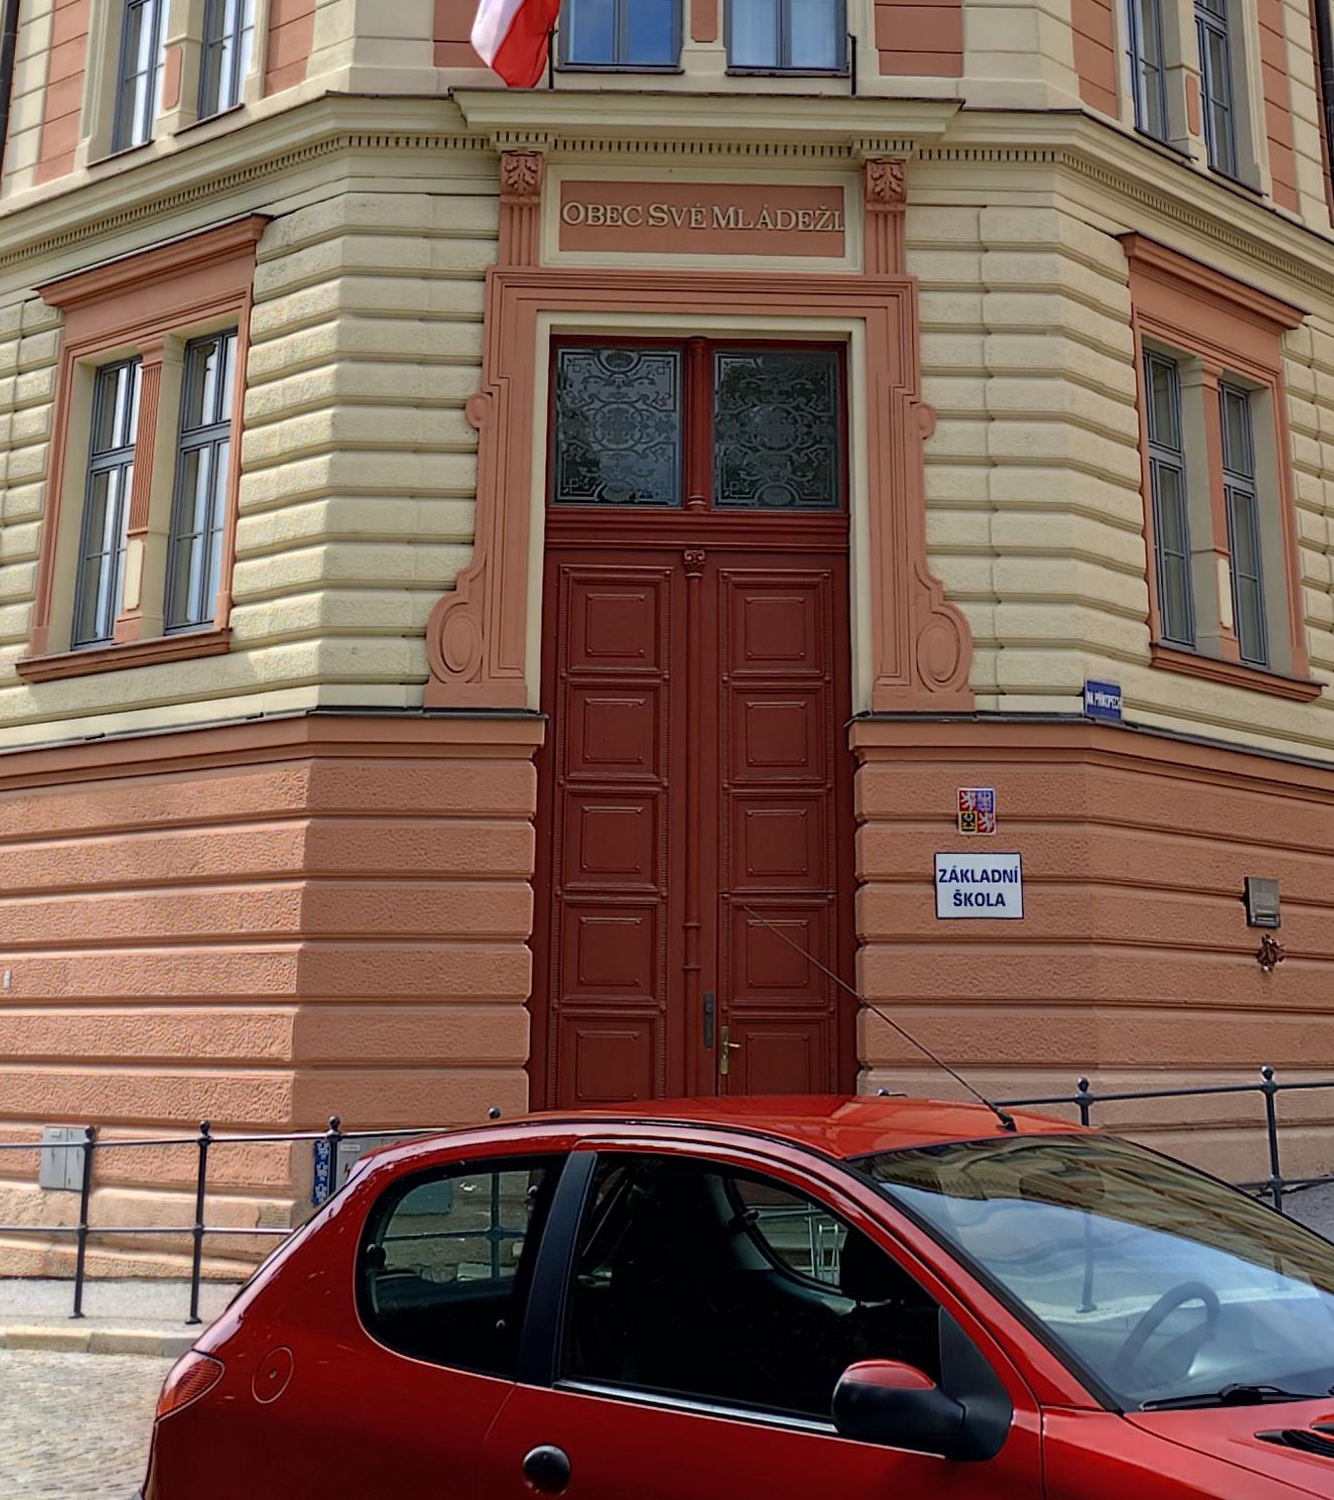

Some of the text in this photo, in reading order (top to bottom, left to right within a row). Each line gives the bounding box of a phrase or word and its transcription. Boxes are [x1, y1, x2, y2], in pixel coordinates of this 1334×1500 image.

[562, 202, 643, 228] OBEC
[647, 202, 707, 230] SVÉ
[938, 865, 1019, 883] ZÁKLADNÍ
[952, 889, 1006, 907] ŠKOLA
